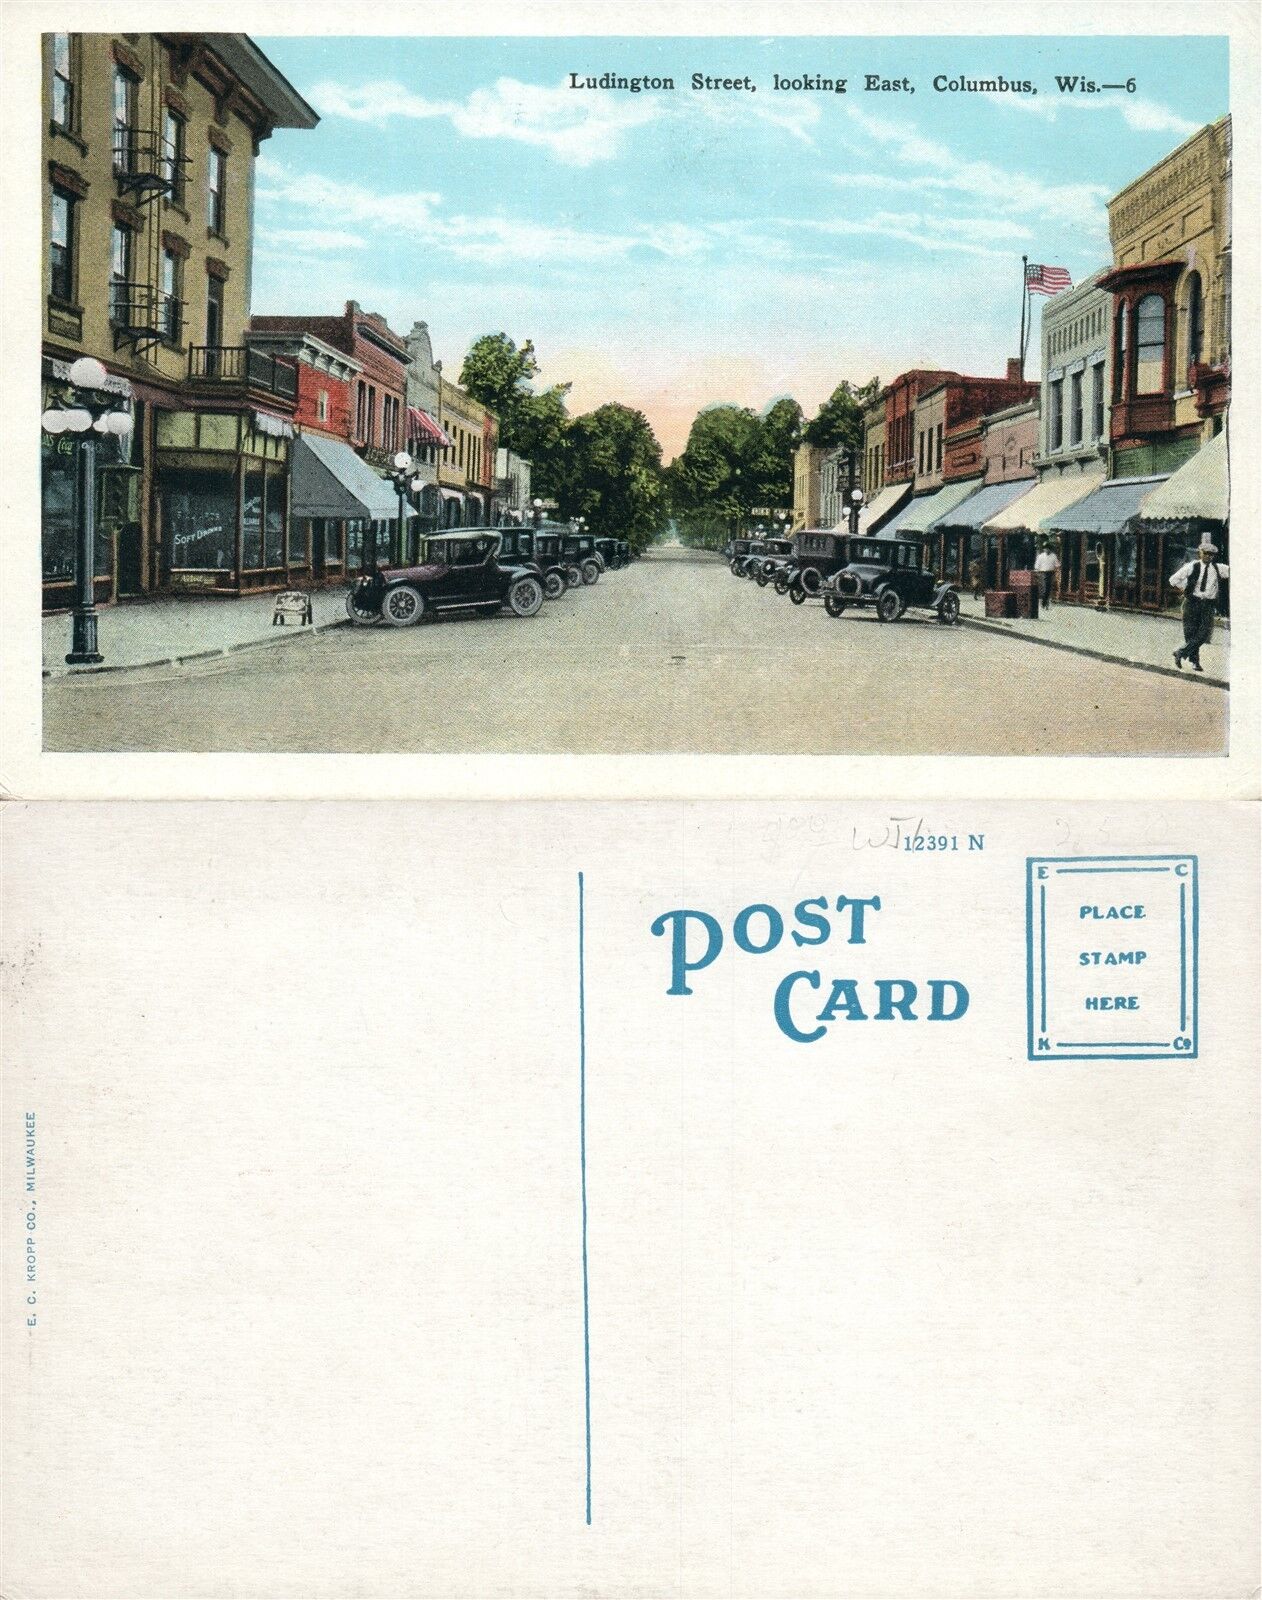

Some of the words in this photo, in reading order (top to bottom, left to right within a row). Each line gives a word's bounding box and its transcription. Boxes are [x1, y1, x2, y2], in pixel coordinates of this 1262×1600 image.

[904, 835, 959, 851] 12391
[968, 834, 985, 851] N
[1079, 905, 1147, 920] PLACE
[650, 894, 882, 996] POST
[1079, 950, 1147, 966] STAMP
[773, 969, 971, 1044] CARD
[1085, 996, 1141, 1011] HERE
[25, 1112, 36, 1192] MILWAUKEE
[26, 1237, 36, 1282] KROPP
[26, 1290, 37, 1305] C.
[27, 1313, 37, 1327] E.
